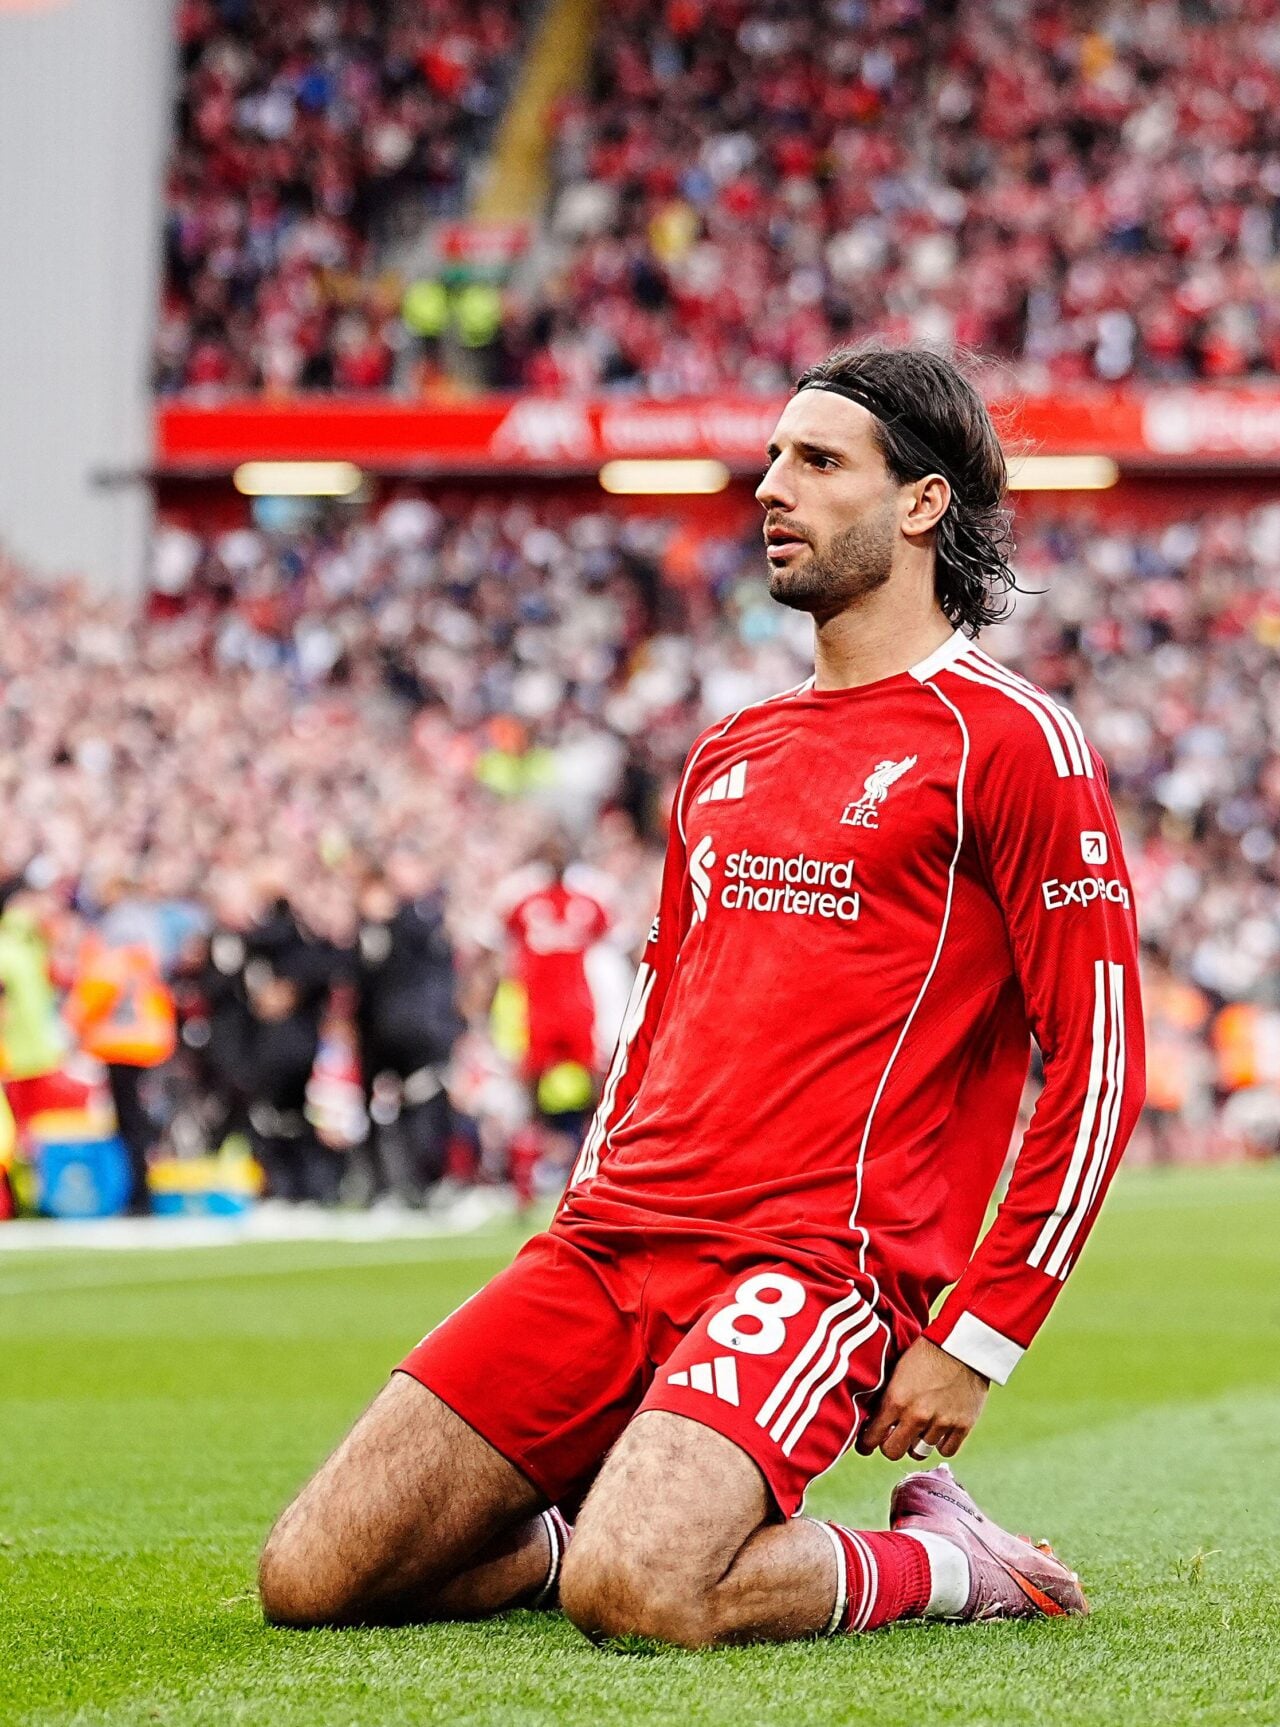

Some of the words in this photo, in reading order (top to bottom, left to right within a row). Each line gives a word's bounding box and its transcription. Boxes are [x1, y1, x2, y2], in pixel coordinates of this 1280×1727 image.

[724, 849, 854, 889] standard
[721, 881, 860, 921] chartered
[1042, 877, 1130, 910] Exped
[707, 1273, 806, 1355] 8
